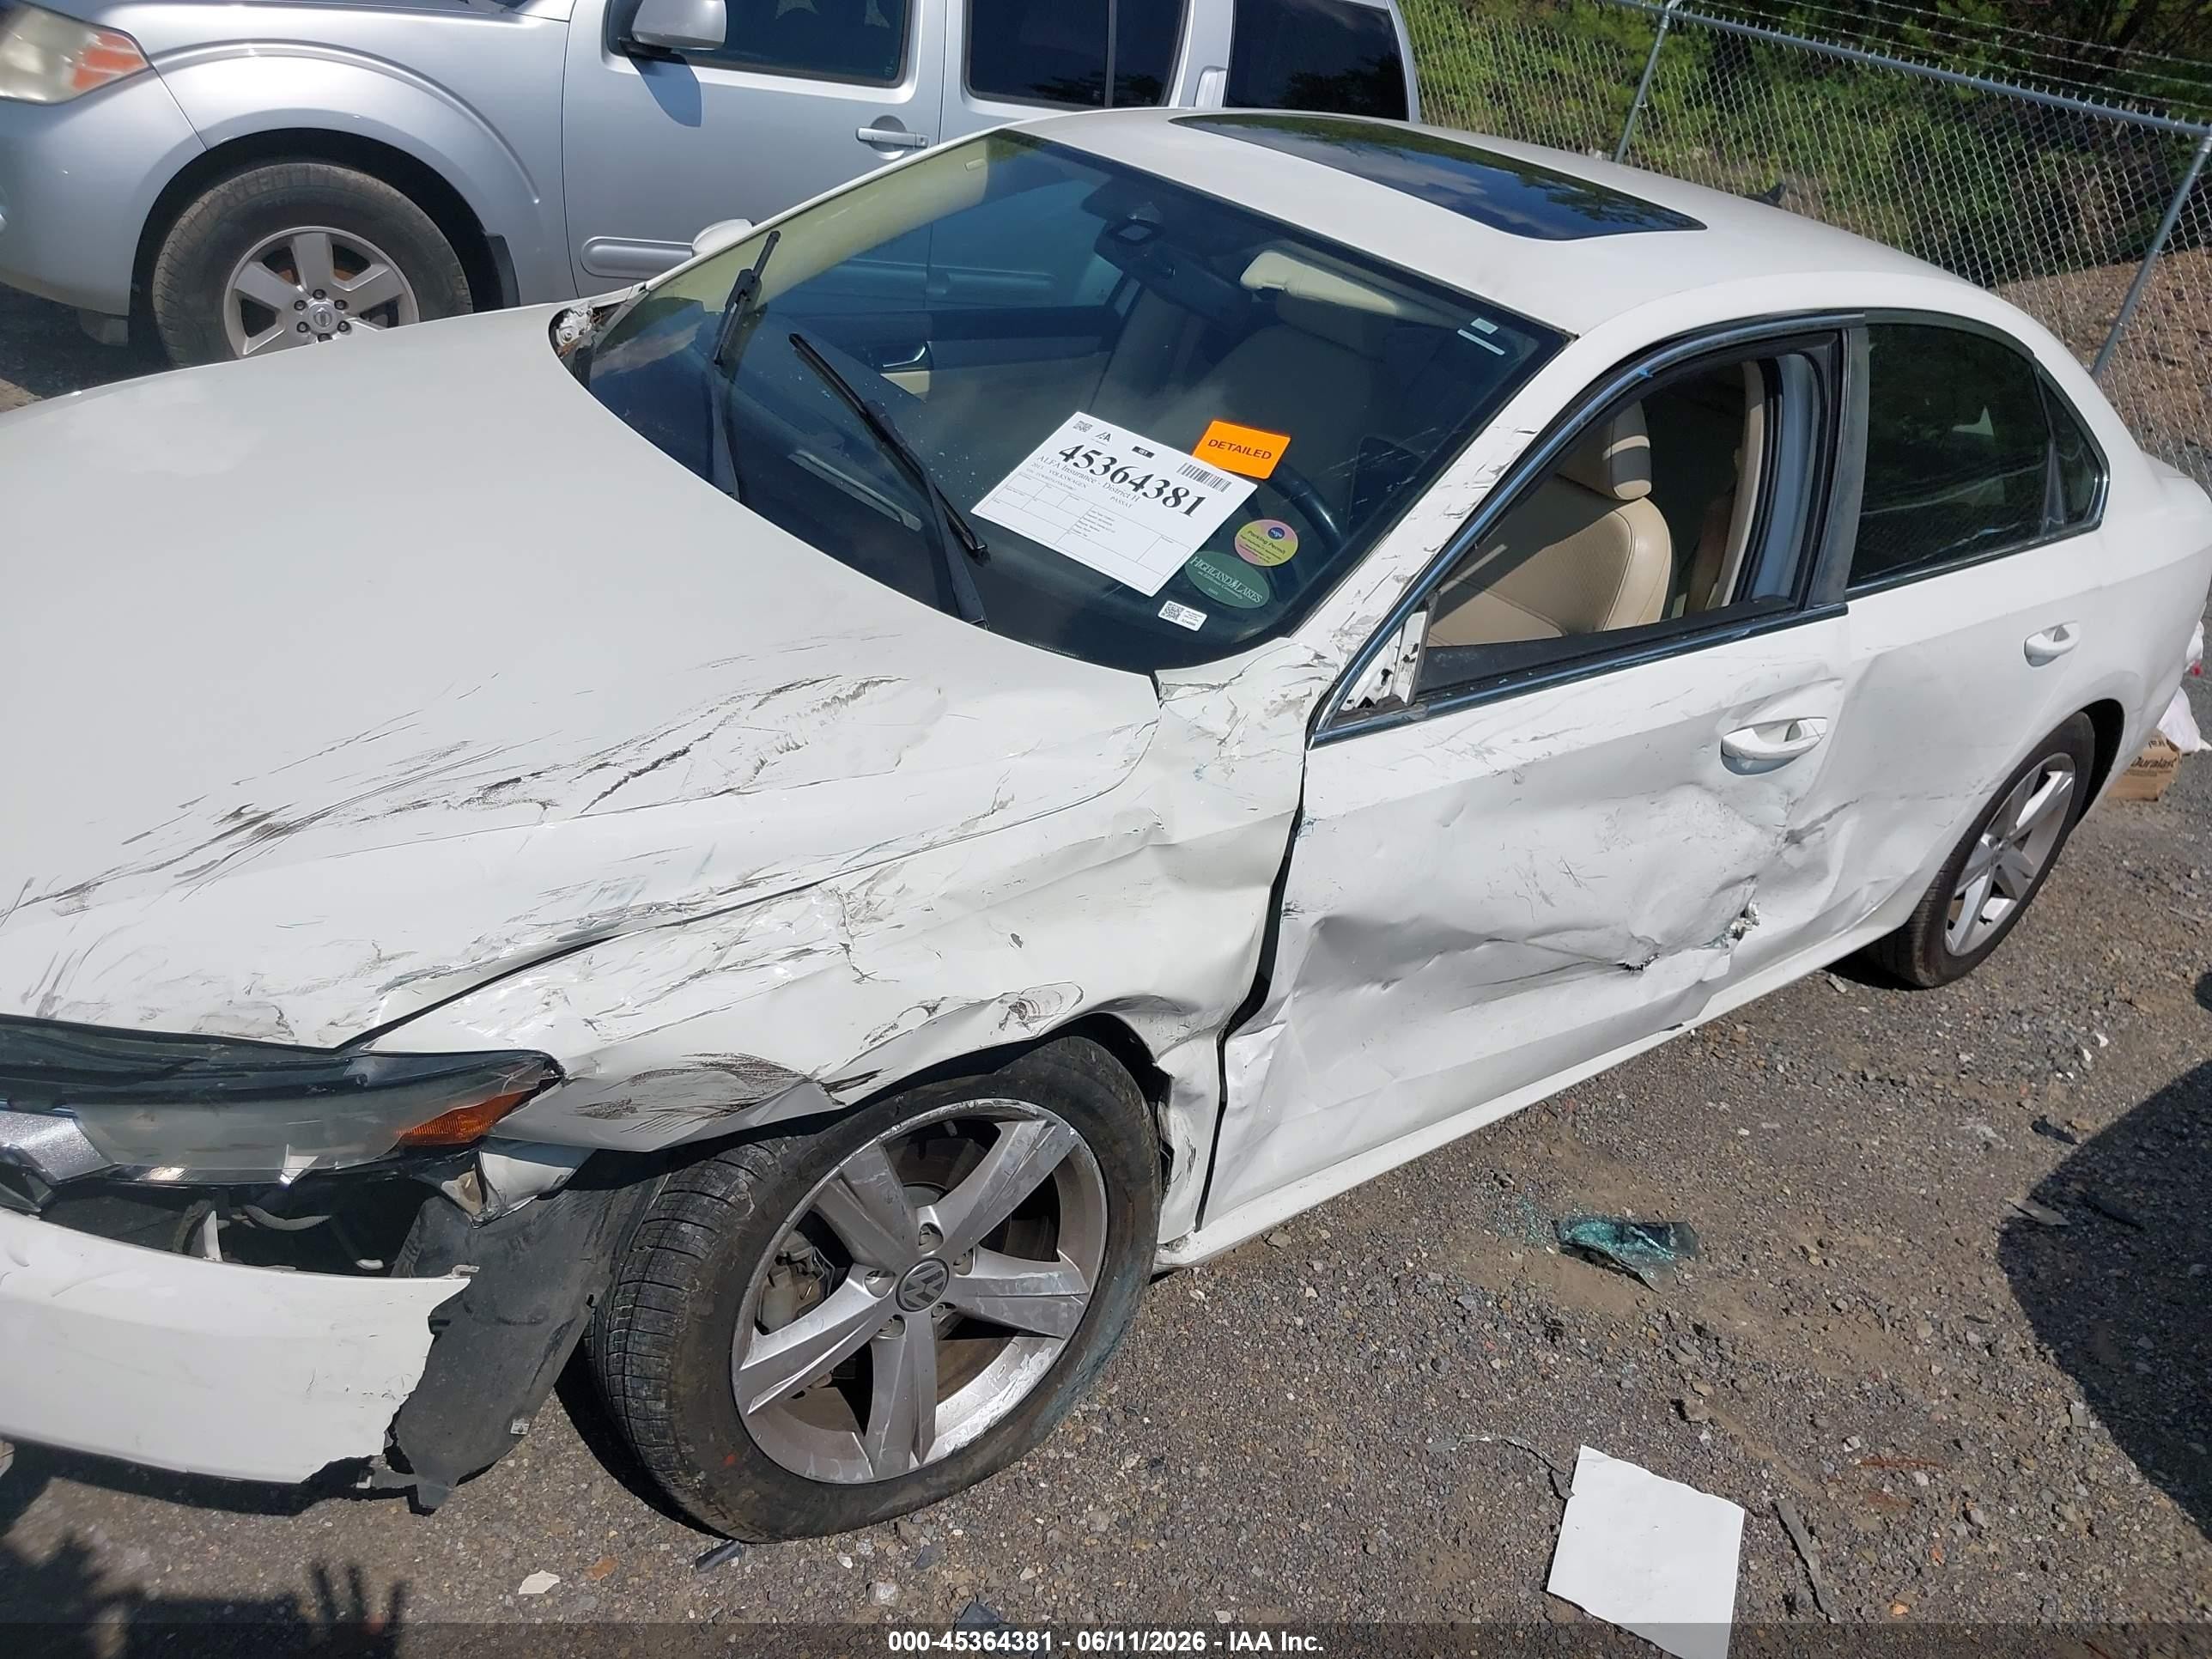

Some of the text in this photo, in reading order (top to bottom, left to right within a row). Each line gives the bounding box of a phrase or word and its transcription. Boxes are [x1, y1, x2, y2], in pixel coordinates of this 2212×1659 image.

[1207, 439, 1272, 459] DETAILED
[1036, 455, 1060, 470] ALFA
[1060, 465, 1097, 484] Insurance
[1102, 481, 1133, 500] District
[1058, 444, 1206, 518] 45364381
[1189, 556, 1263, 603] HIGHLAND LAKES
